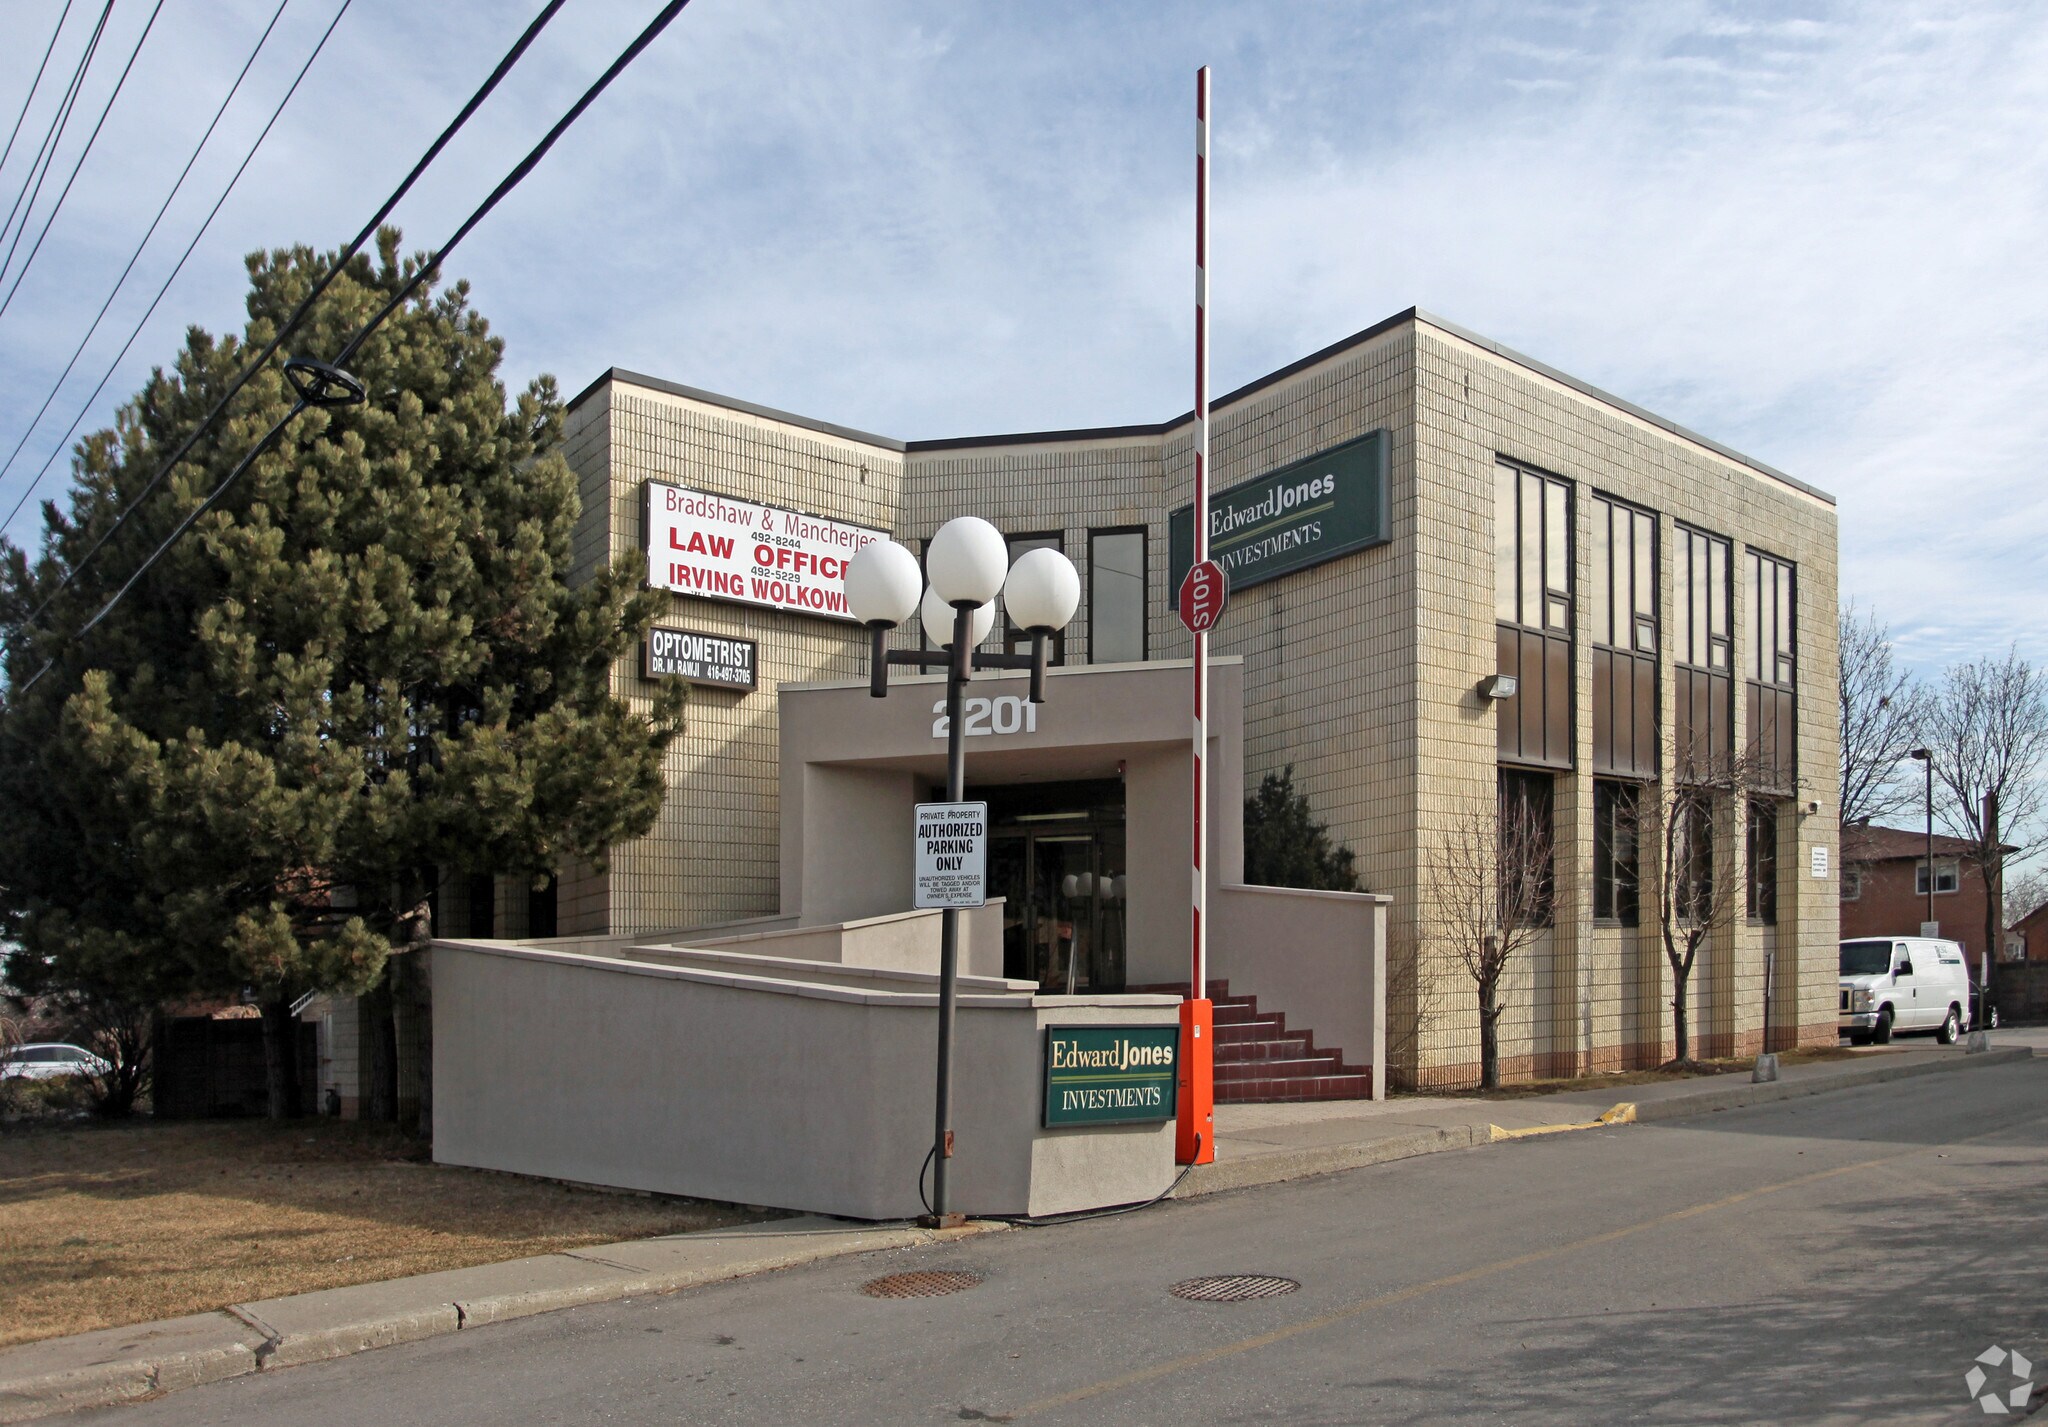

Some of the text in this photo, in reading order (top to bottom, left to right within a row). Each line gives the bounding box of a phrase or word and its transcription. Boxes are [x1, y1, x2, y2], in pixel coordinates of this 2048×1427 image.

[666, 488, 753, 526] Bradshaw
[761, 509, 773, 531] &
[669, 526, 735, 559] LAW
[751, 532, 801, 549] 492-8244
[1220, 521, 1322, 572] INVESTMENTS
[669, 562, 744, 596] IRVING
[751, 566, 801, 583] 492-5229
[1193, 568, 1210, 628] STOP
[653, 630, 751, 667] OPTOMETRIST
[652, 656, 665, 673] DR.
[677, 660, 700, 677] RAWJI
[707, 665, 751, 684] 416-497-3705
[932, 695, 1036, 738] 2201
[920, 810, 981, 820] PRIVATE PROPERTY
[918, 822, 983, 839] AUTHORIZED
[927, 839, 973, 855] PARKING
[936, 856, 963, 871] ONLY
[1062, 1087, 1161, 1111] INVESTMENTS
